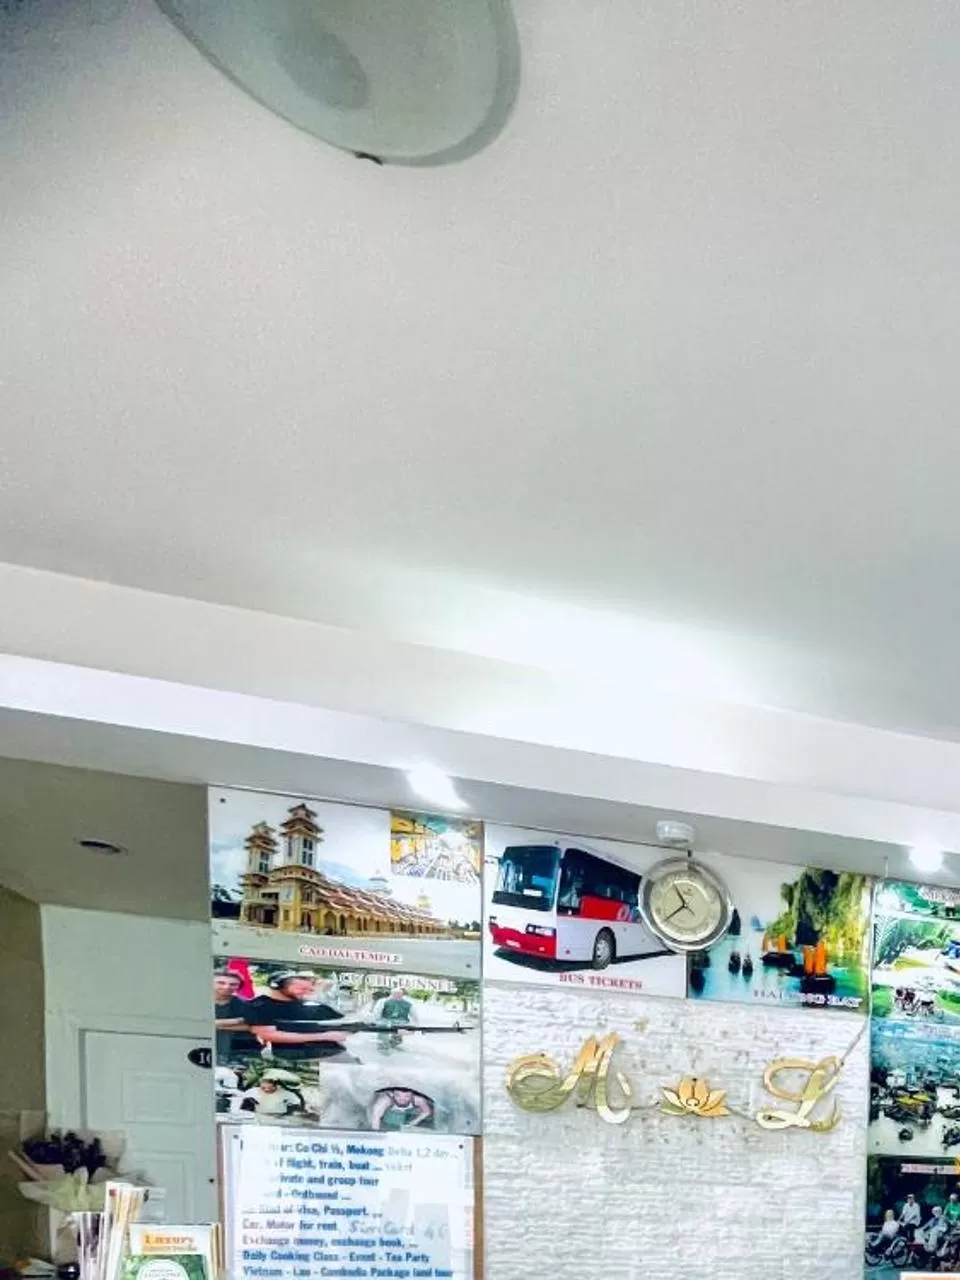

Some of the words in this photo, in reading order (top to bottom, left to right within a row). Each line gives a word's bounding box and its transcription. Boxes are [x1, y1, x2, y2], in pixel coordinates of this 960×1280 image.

[354, 951, 401, 964] TEMPLE
[558, 973, 584, 985] BUS
[588, 975, 643, 990] TICKETS
[346, 1145, 384, 1157] Mekong
[307, 1175, 324, 1184] and
[327, 1176, 356, 1187] group
[266, 1219, 295, 1229] Motor
[299, 1220, 314, 1230] for
[317, 1221, 337, 1231] rent
[243, 1250, 267, 1262] Daily
[270, 1251, 310, 1262] Cooking
[314, 1252, 338, 1261] Class
[385, 1252, 402, 1262] Tea
[405, 1253, 430, 1265] Party
[243, 1266, 282, 1276] Vietnam
[321, 1266, 367, 1277] Cambodia
[370, 1268, 410, 1278] Package
